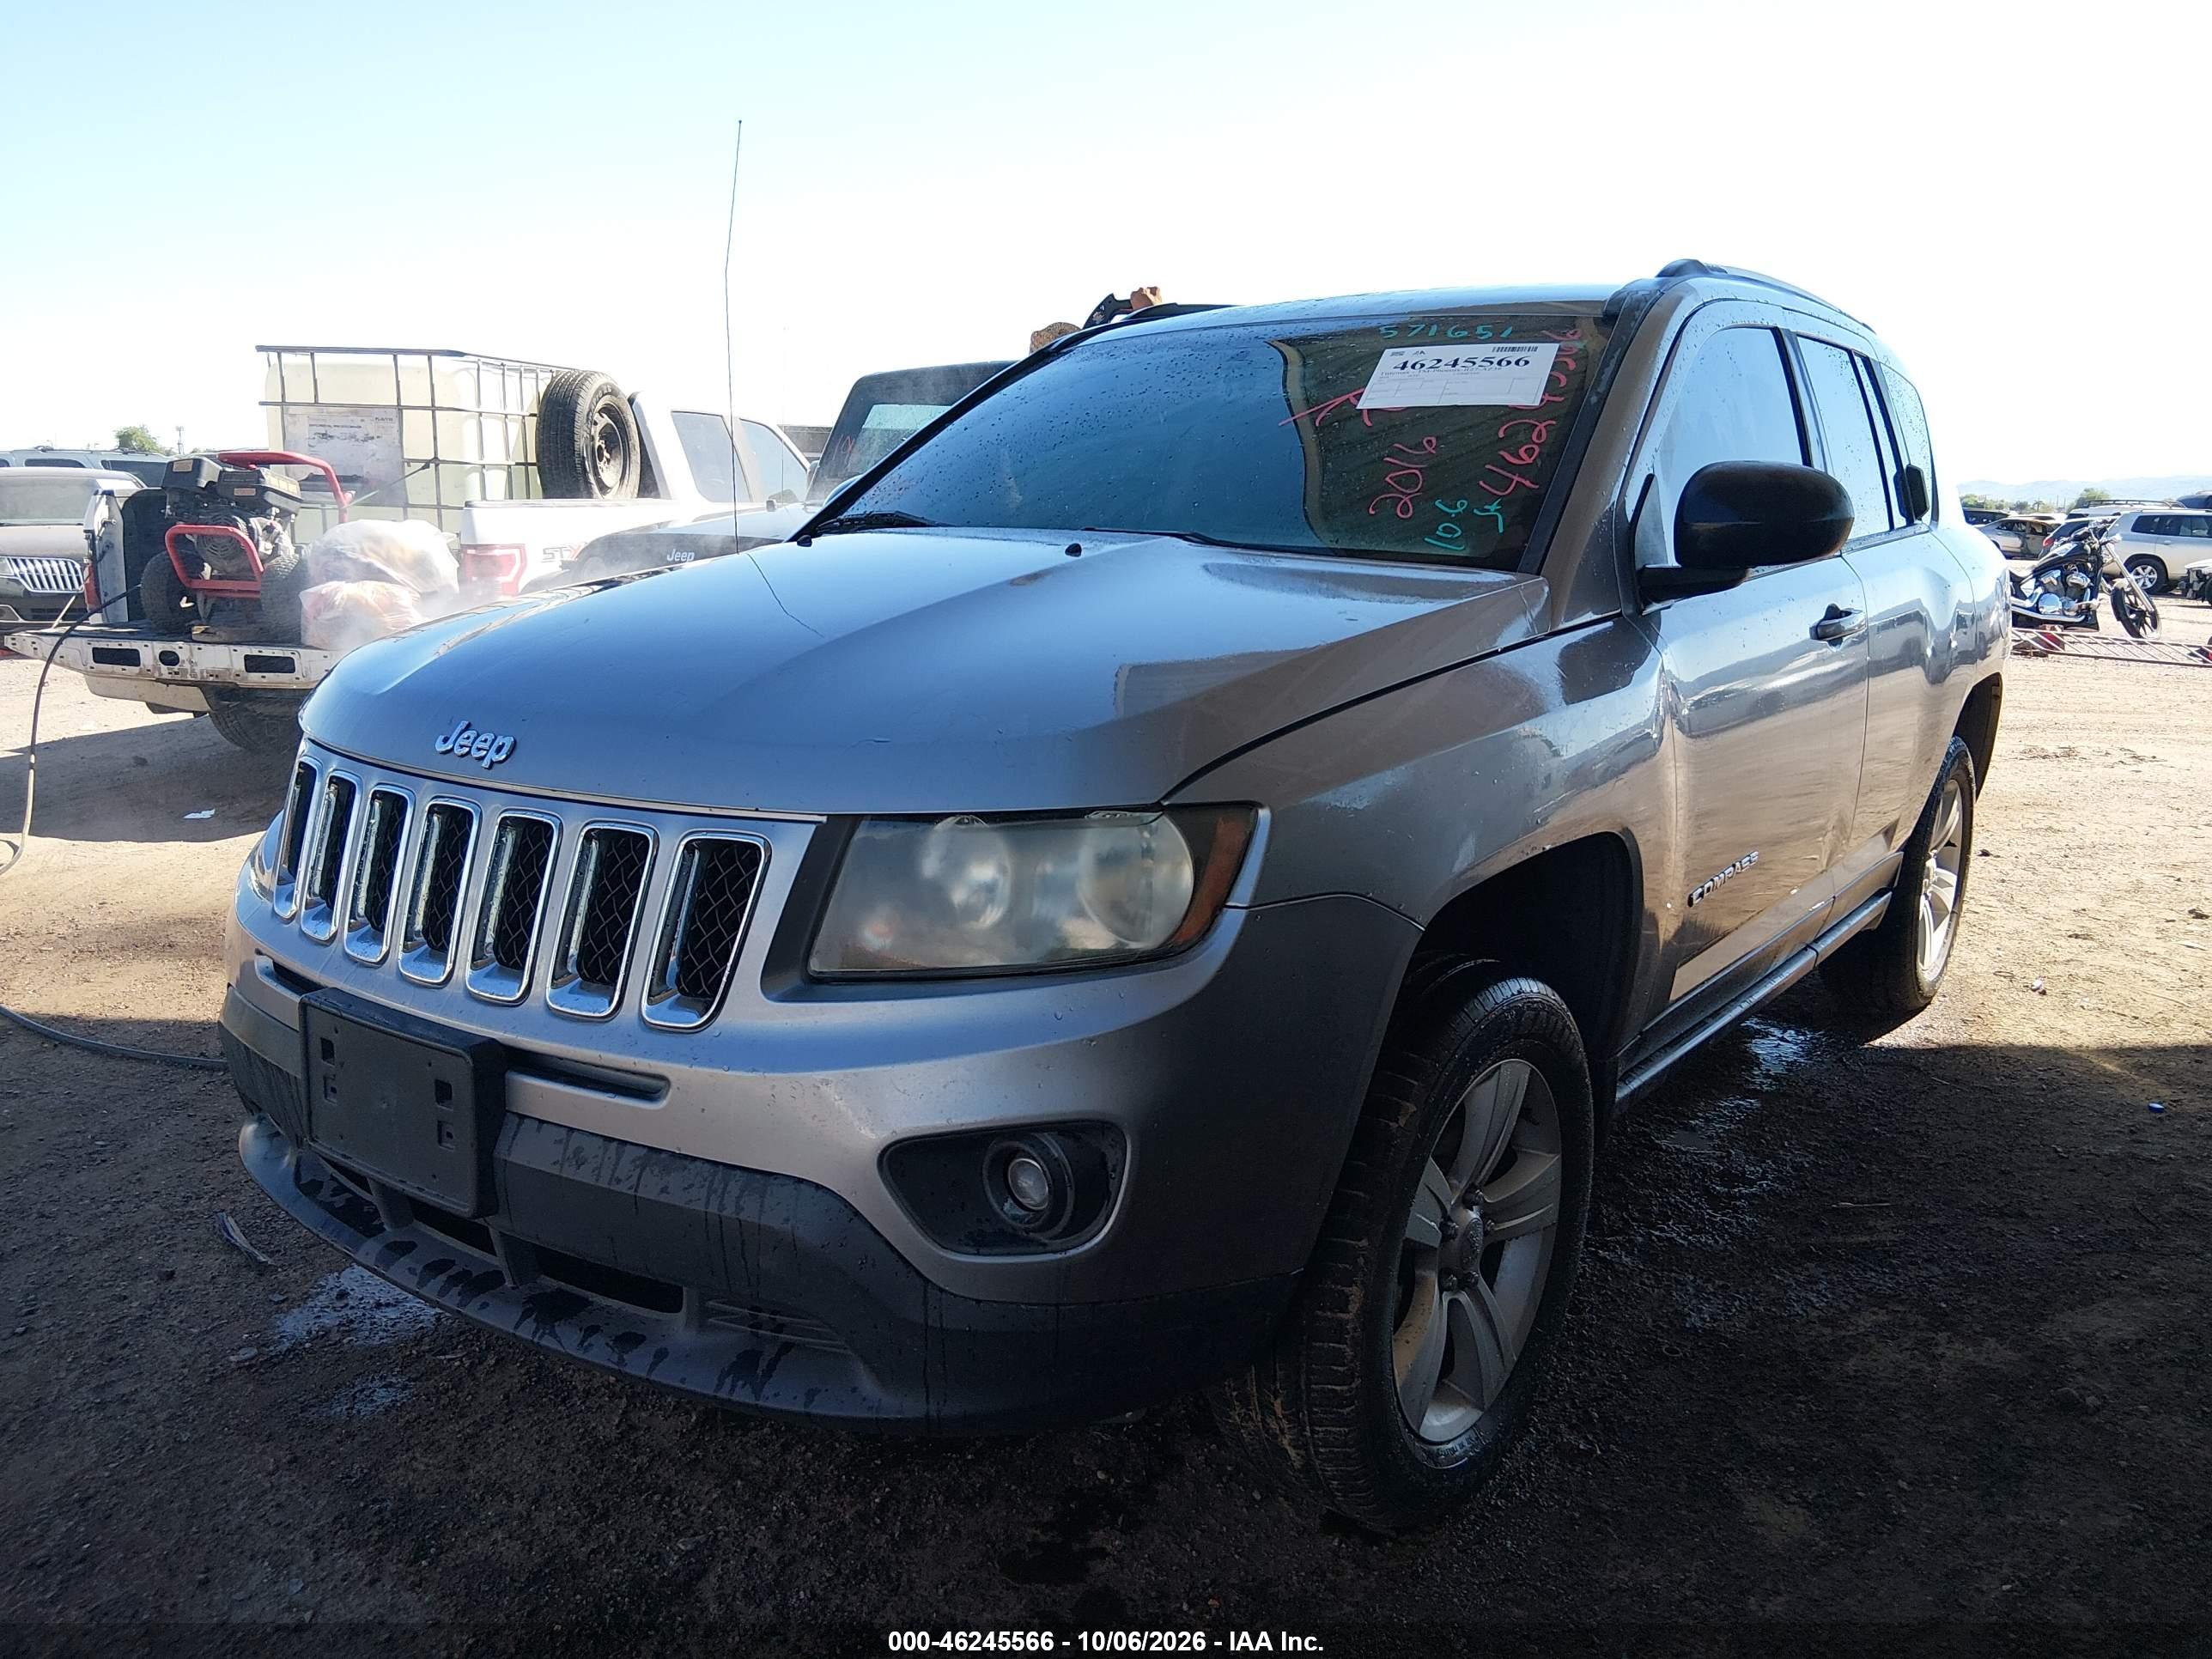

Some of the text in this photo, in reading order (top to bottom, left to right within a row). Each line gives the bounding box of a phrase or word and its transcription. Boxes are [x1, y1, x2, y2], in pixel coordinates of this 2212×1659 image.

[1379, 324, 1513, 339] 571651
[1393, 356, 1531, 371] 46245566
[1369, 436, 1437, 519] 2016
[666, 548, 696, 562] Jeep
[434, 720, 515, 769] Jeep
